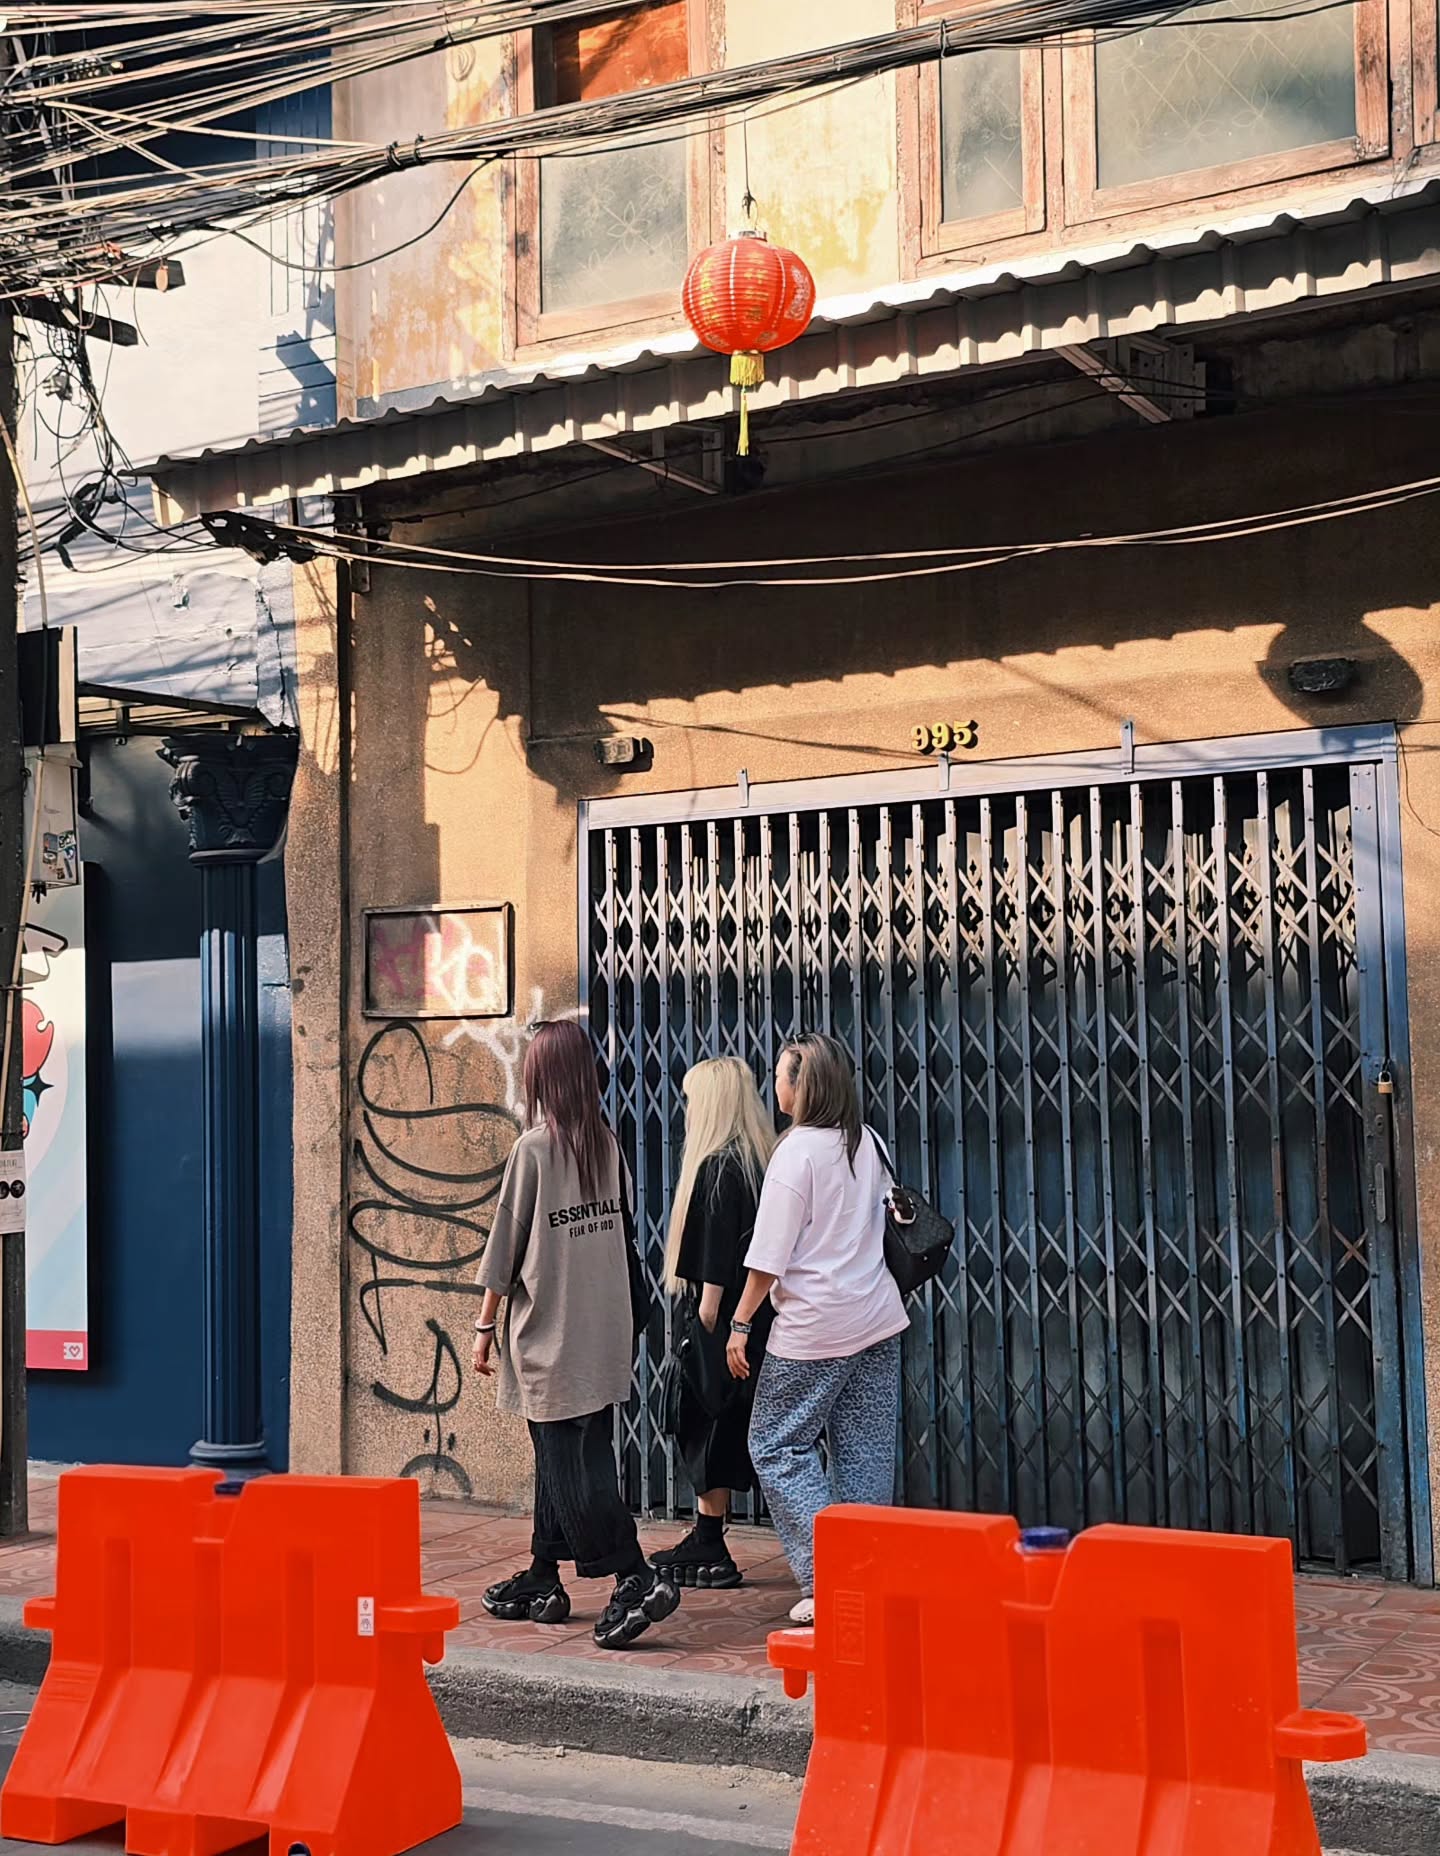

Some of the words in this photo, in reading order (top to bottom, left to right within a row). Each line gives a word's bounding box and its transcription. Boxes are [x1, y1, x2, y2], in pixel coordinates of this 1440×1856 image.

[911, 720, 975, 752] 995
[569, 1225, 586, 1238] FEAR
[588, 1222, 599, 1233] OF
[601, 1220, 614, 1231] GOD
